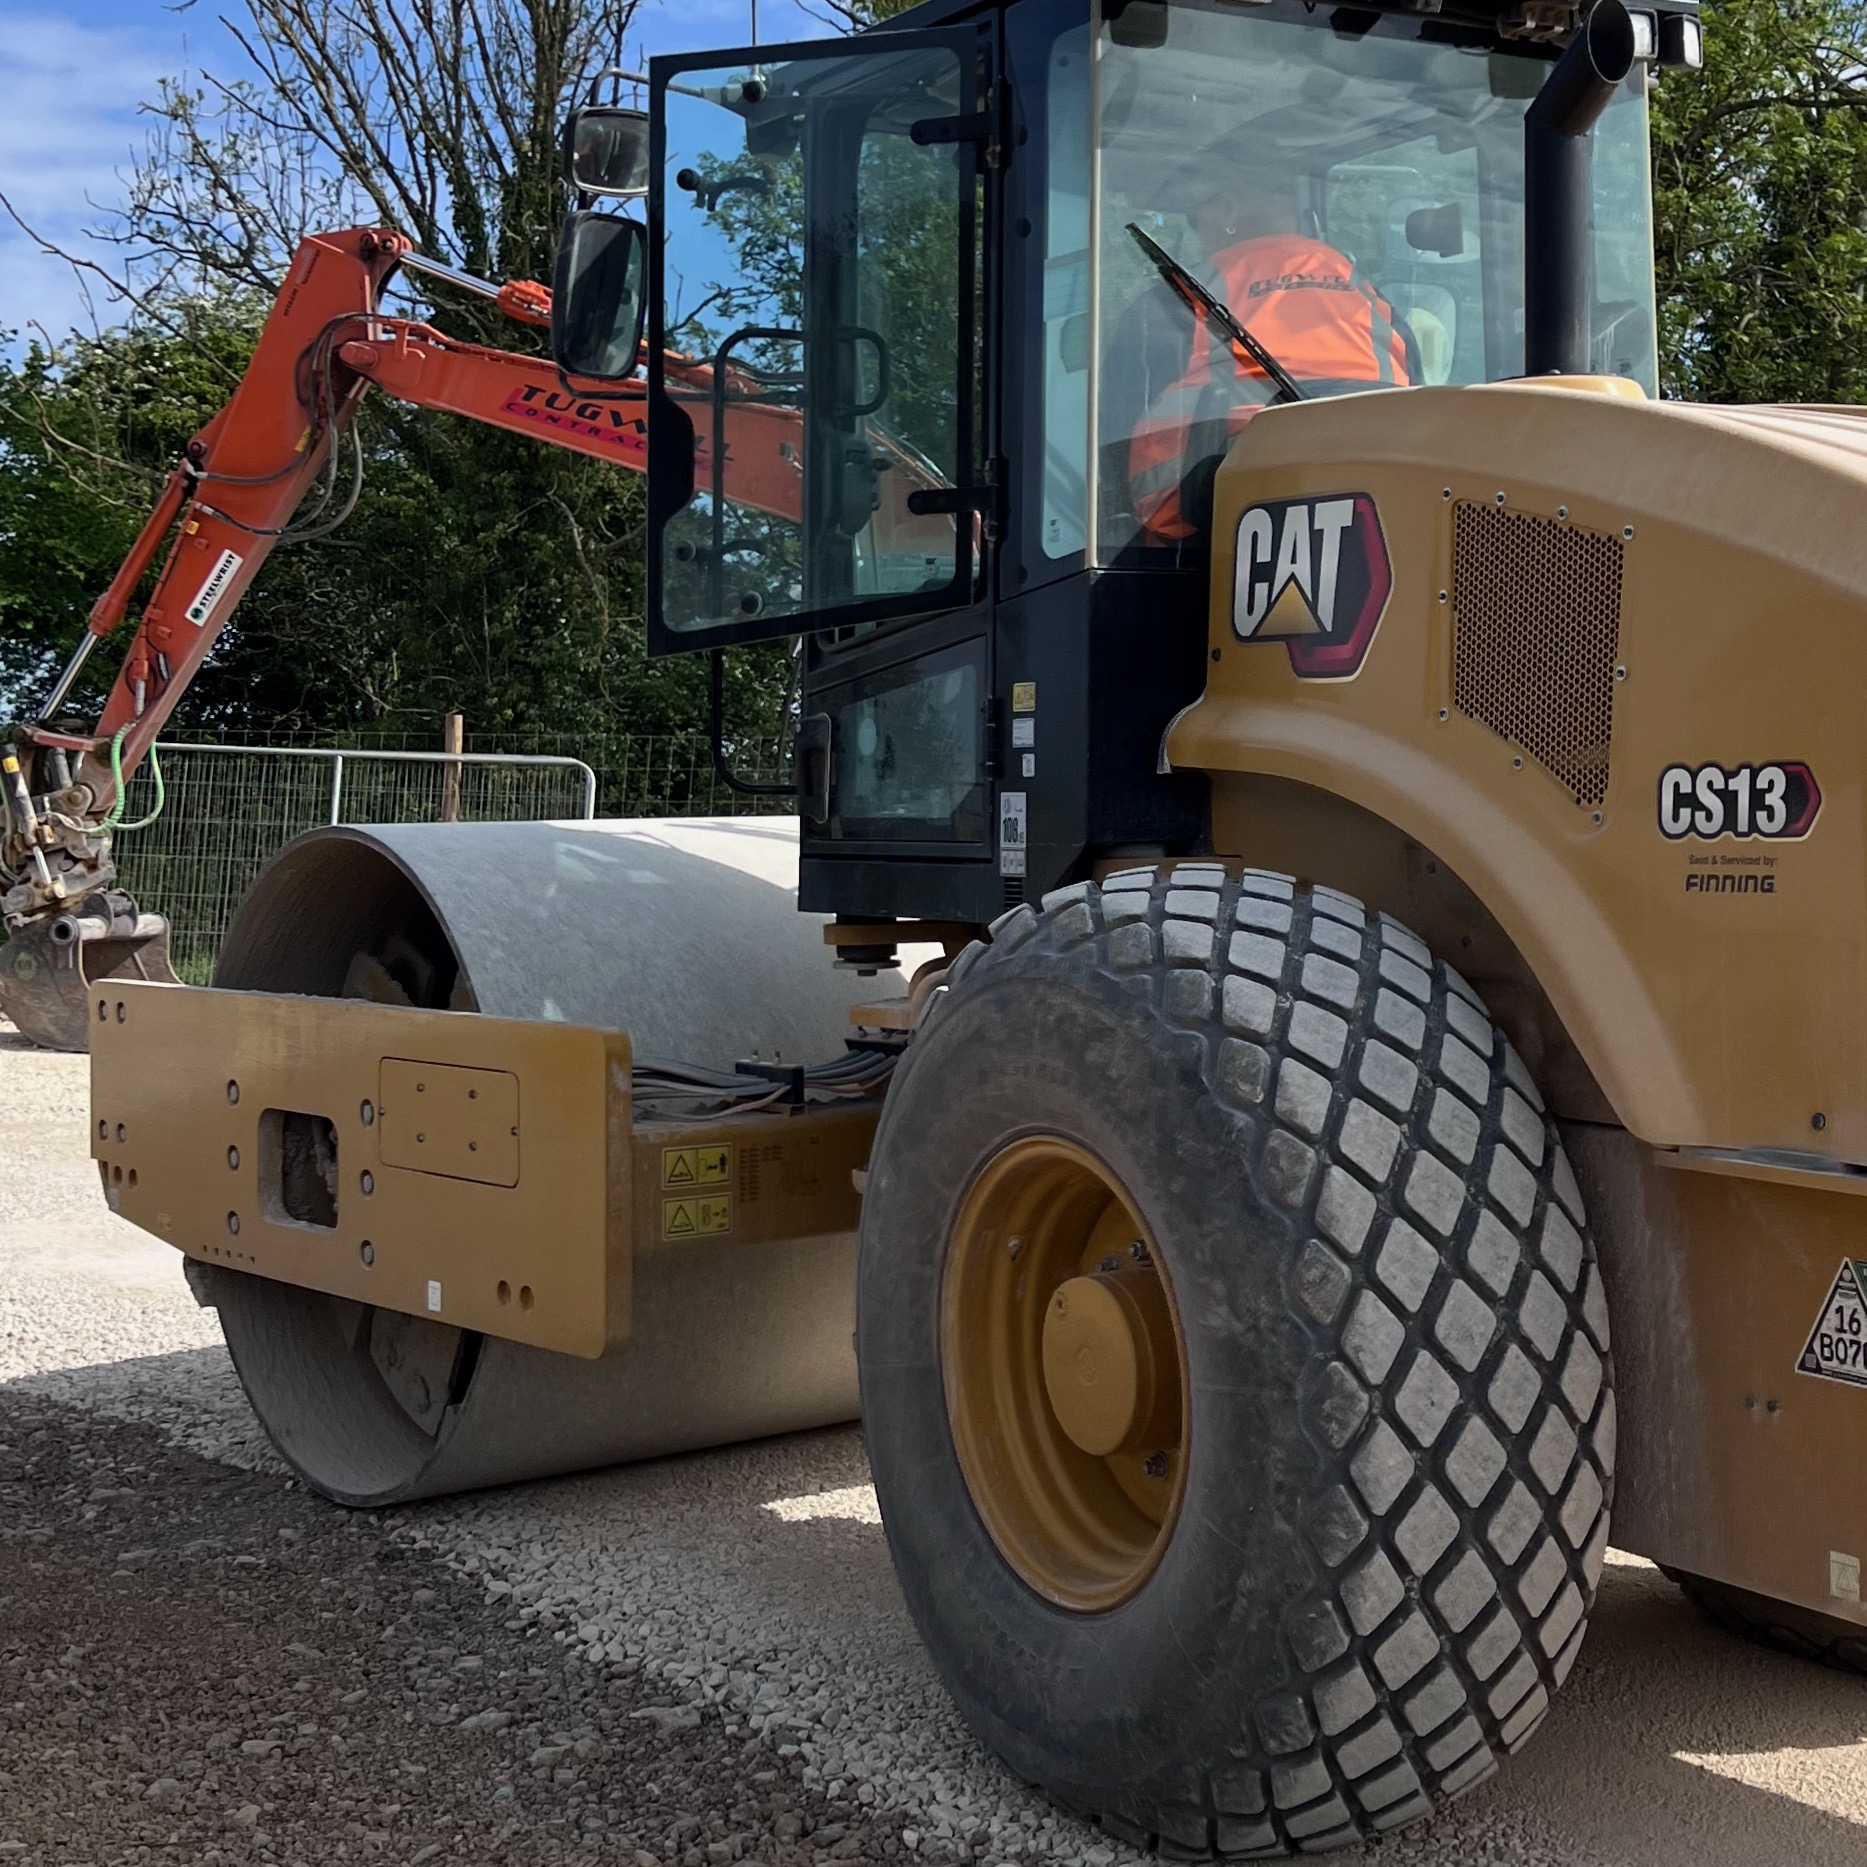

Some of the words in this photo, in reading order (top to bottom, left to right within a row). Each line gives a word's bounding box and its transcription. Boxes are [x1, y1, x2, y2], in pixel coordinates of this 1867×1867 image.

[199, 553, 237, 609] STEELWRIST
[1233, 499, 1355, 638] CAT
[1660, 765, 1788, 835] CS13
[1685, 873, 1776, 894] FINNING
[1834, 1304, 1862, 1336] 16
